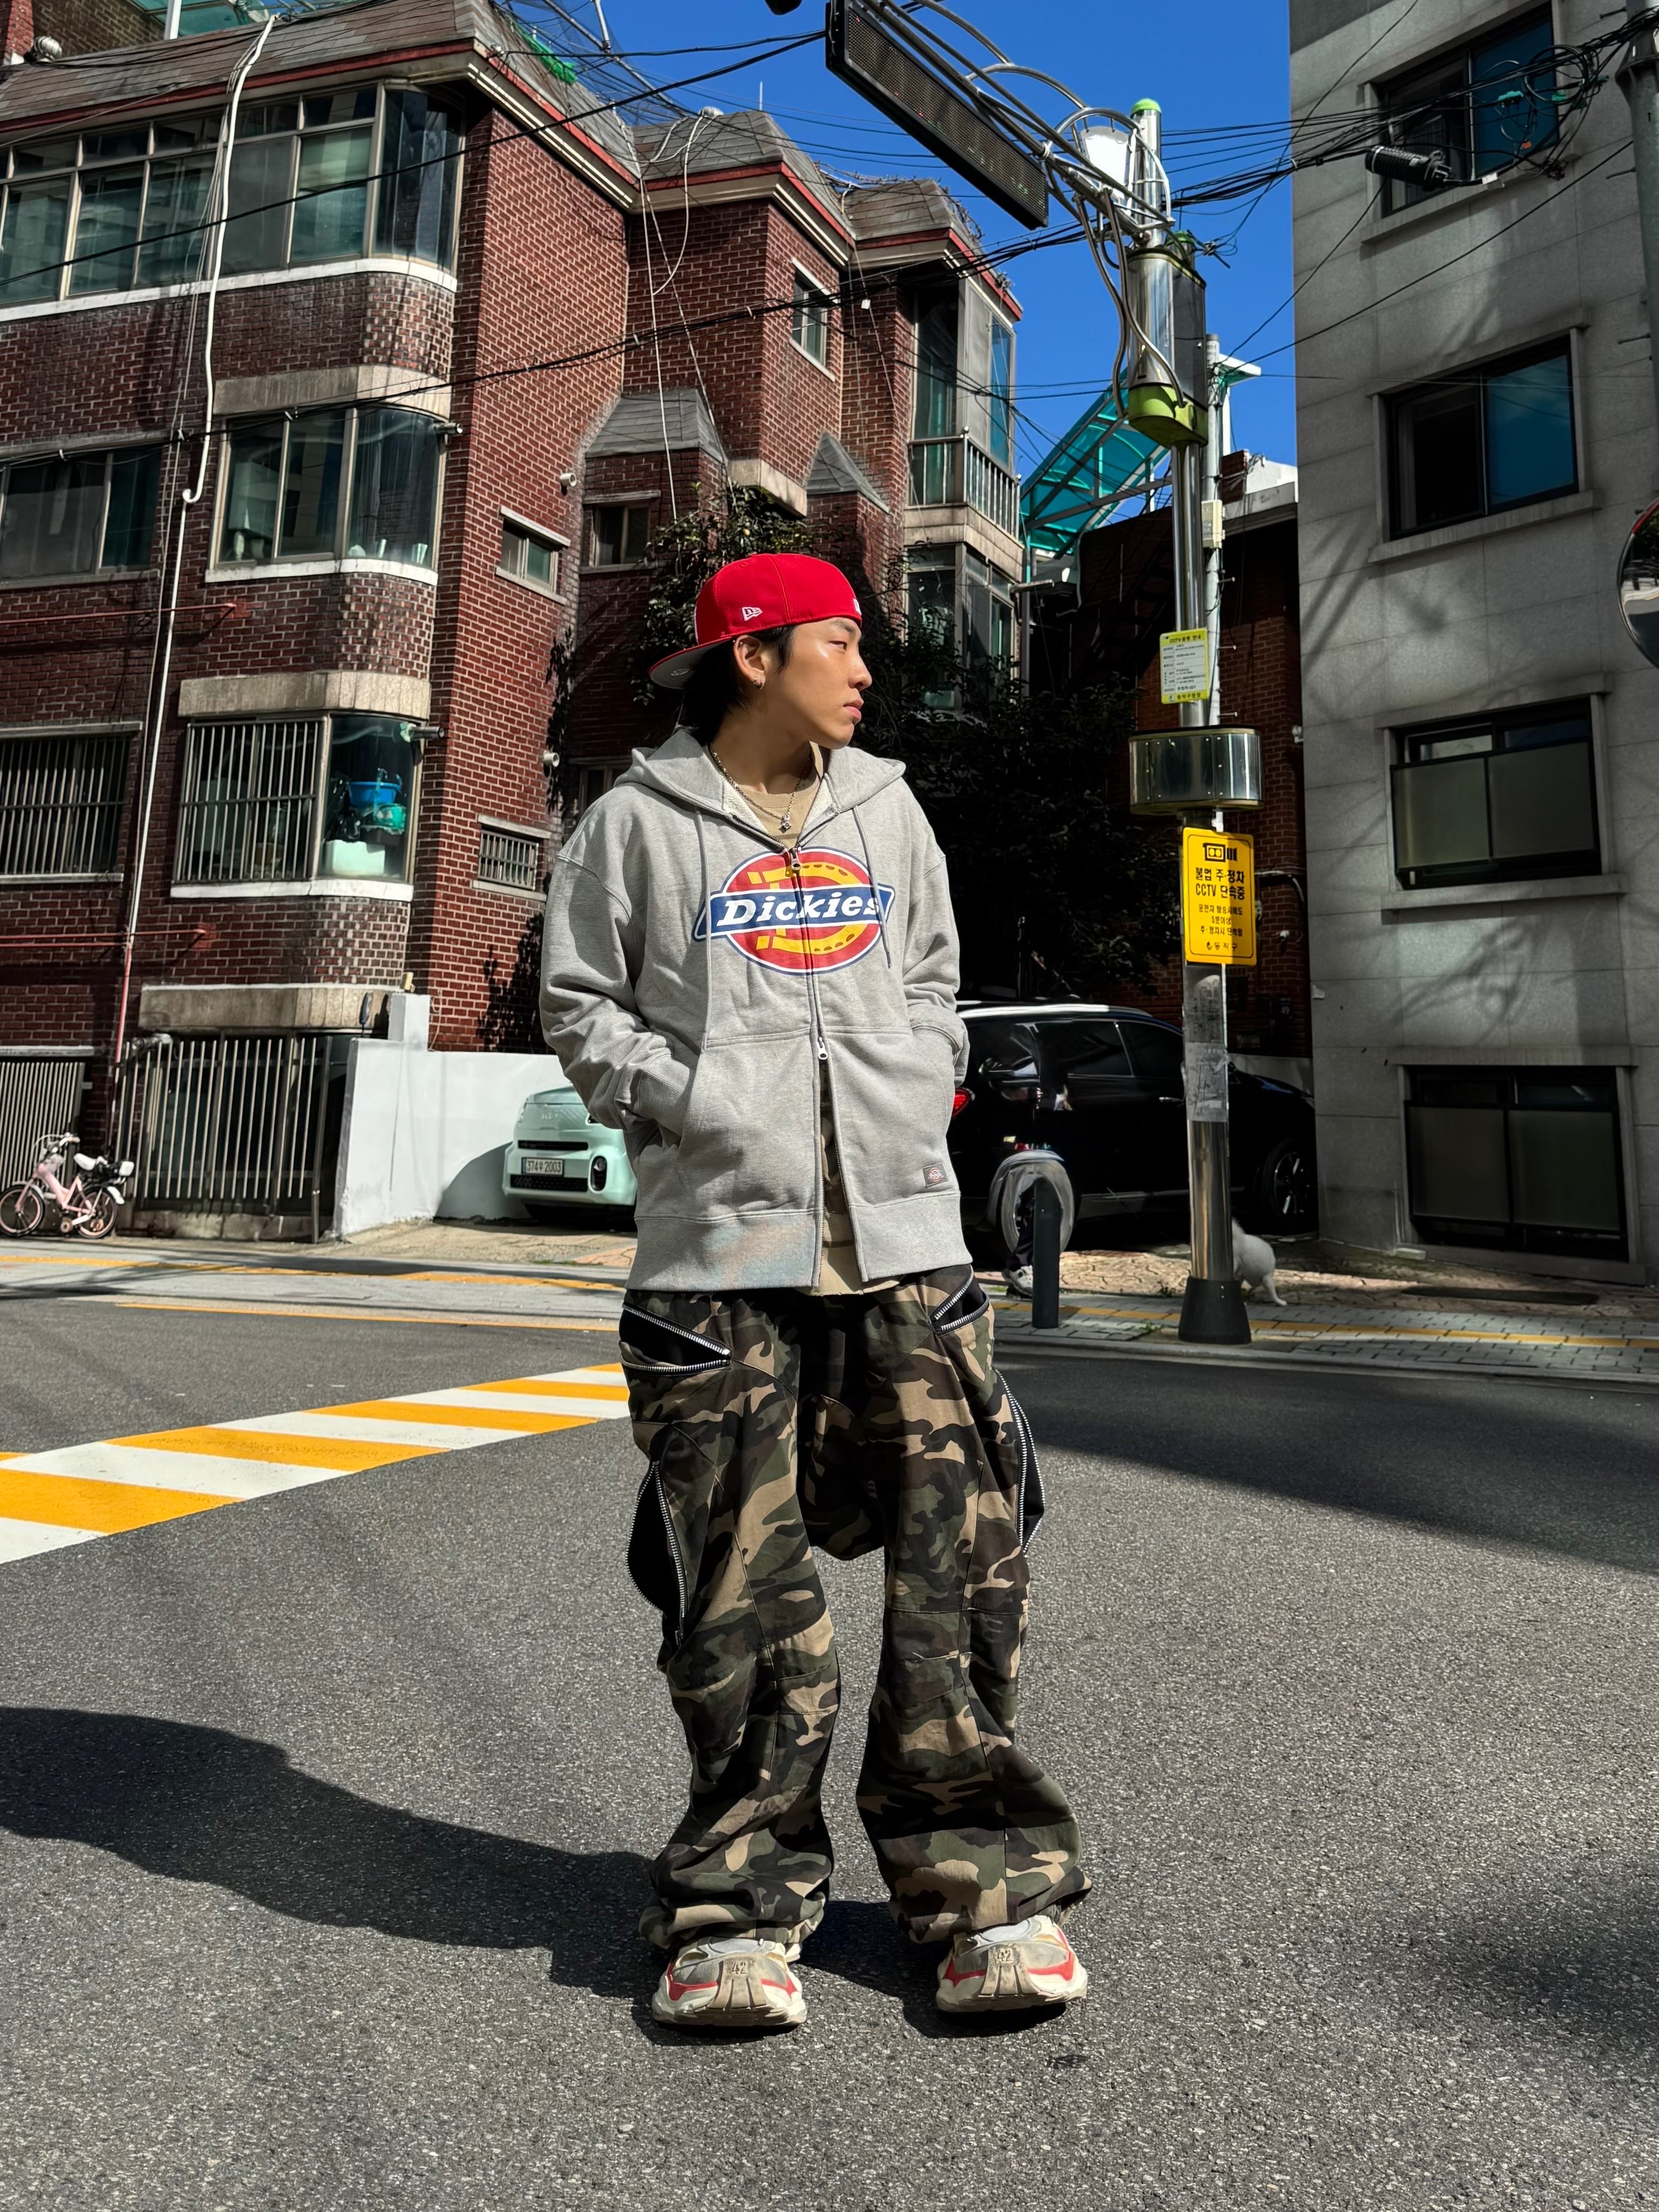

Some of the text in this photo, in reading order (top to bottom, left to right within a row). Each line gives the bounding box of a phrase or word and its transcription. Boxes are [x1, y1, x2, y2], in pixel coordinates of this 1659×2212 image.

[1196, 867, 1212, 881] 불법
[1196, 884, 1244, 900] CCTV 단속중
[716, 892, 880, 927] Dickies
[1198, 904, 1215, 913] 운전자
[1211, 915, 1231, 925] 5분이상
[997, 1949, 1013, 1961] 42
[732, 1961, 748, 1974] 42
